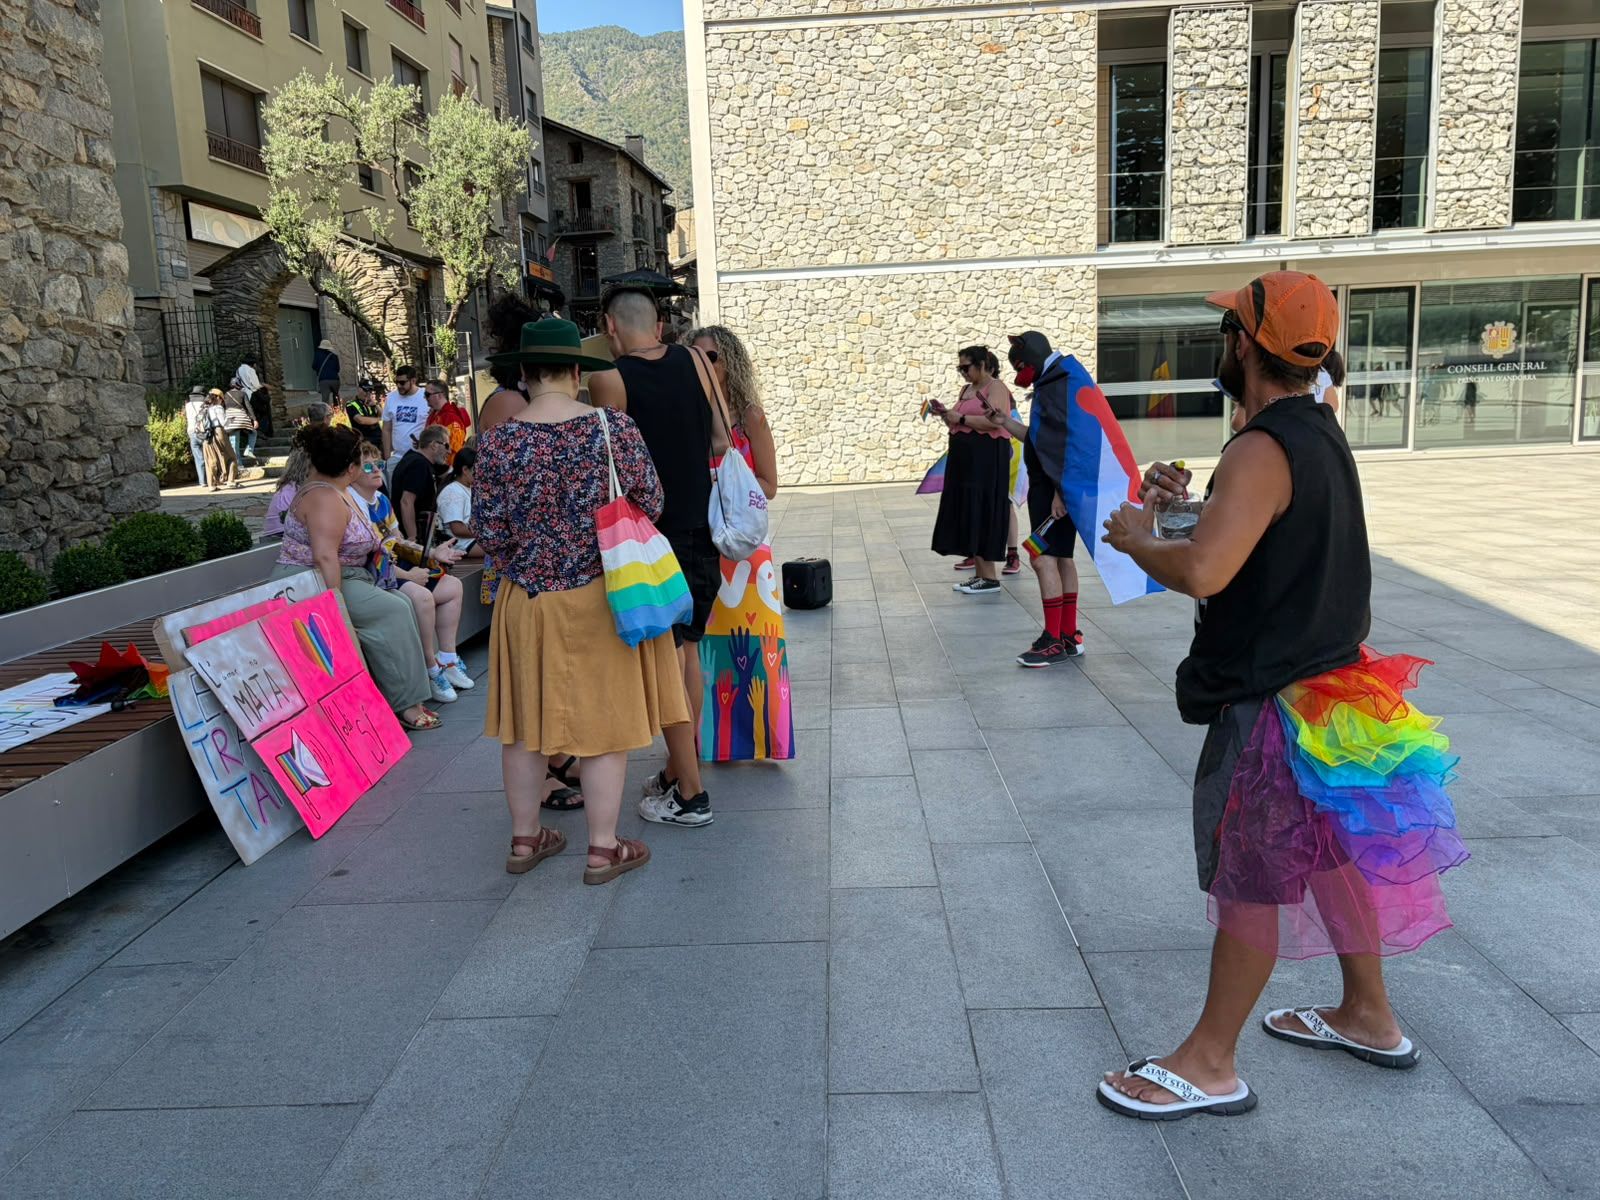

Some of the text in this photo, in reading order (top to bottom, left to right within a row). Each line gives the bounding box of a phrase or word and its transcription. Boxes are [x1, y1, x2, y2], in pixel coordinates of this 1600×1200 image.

[1447, 361, 1548, 374] CONSELL GENERAL
[1457, 375, 1494, 385] PRINCIPAT
[232, 667, 291, 728] MATA
[1145, 1067, 1168, 1078] STAR
[1170, 1078, 1193, 1093] STAR
